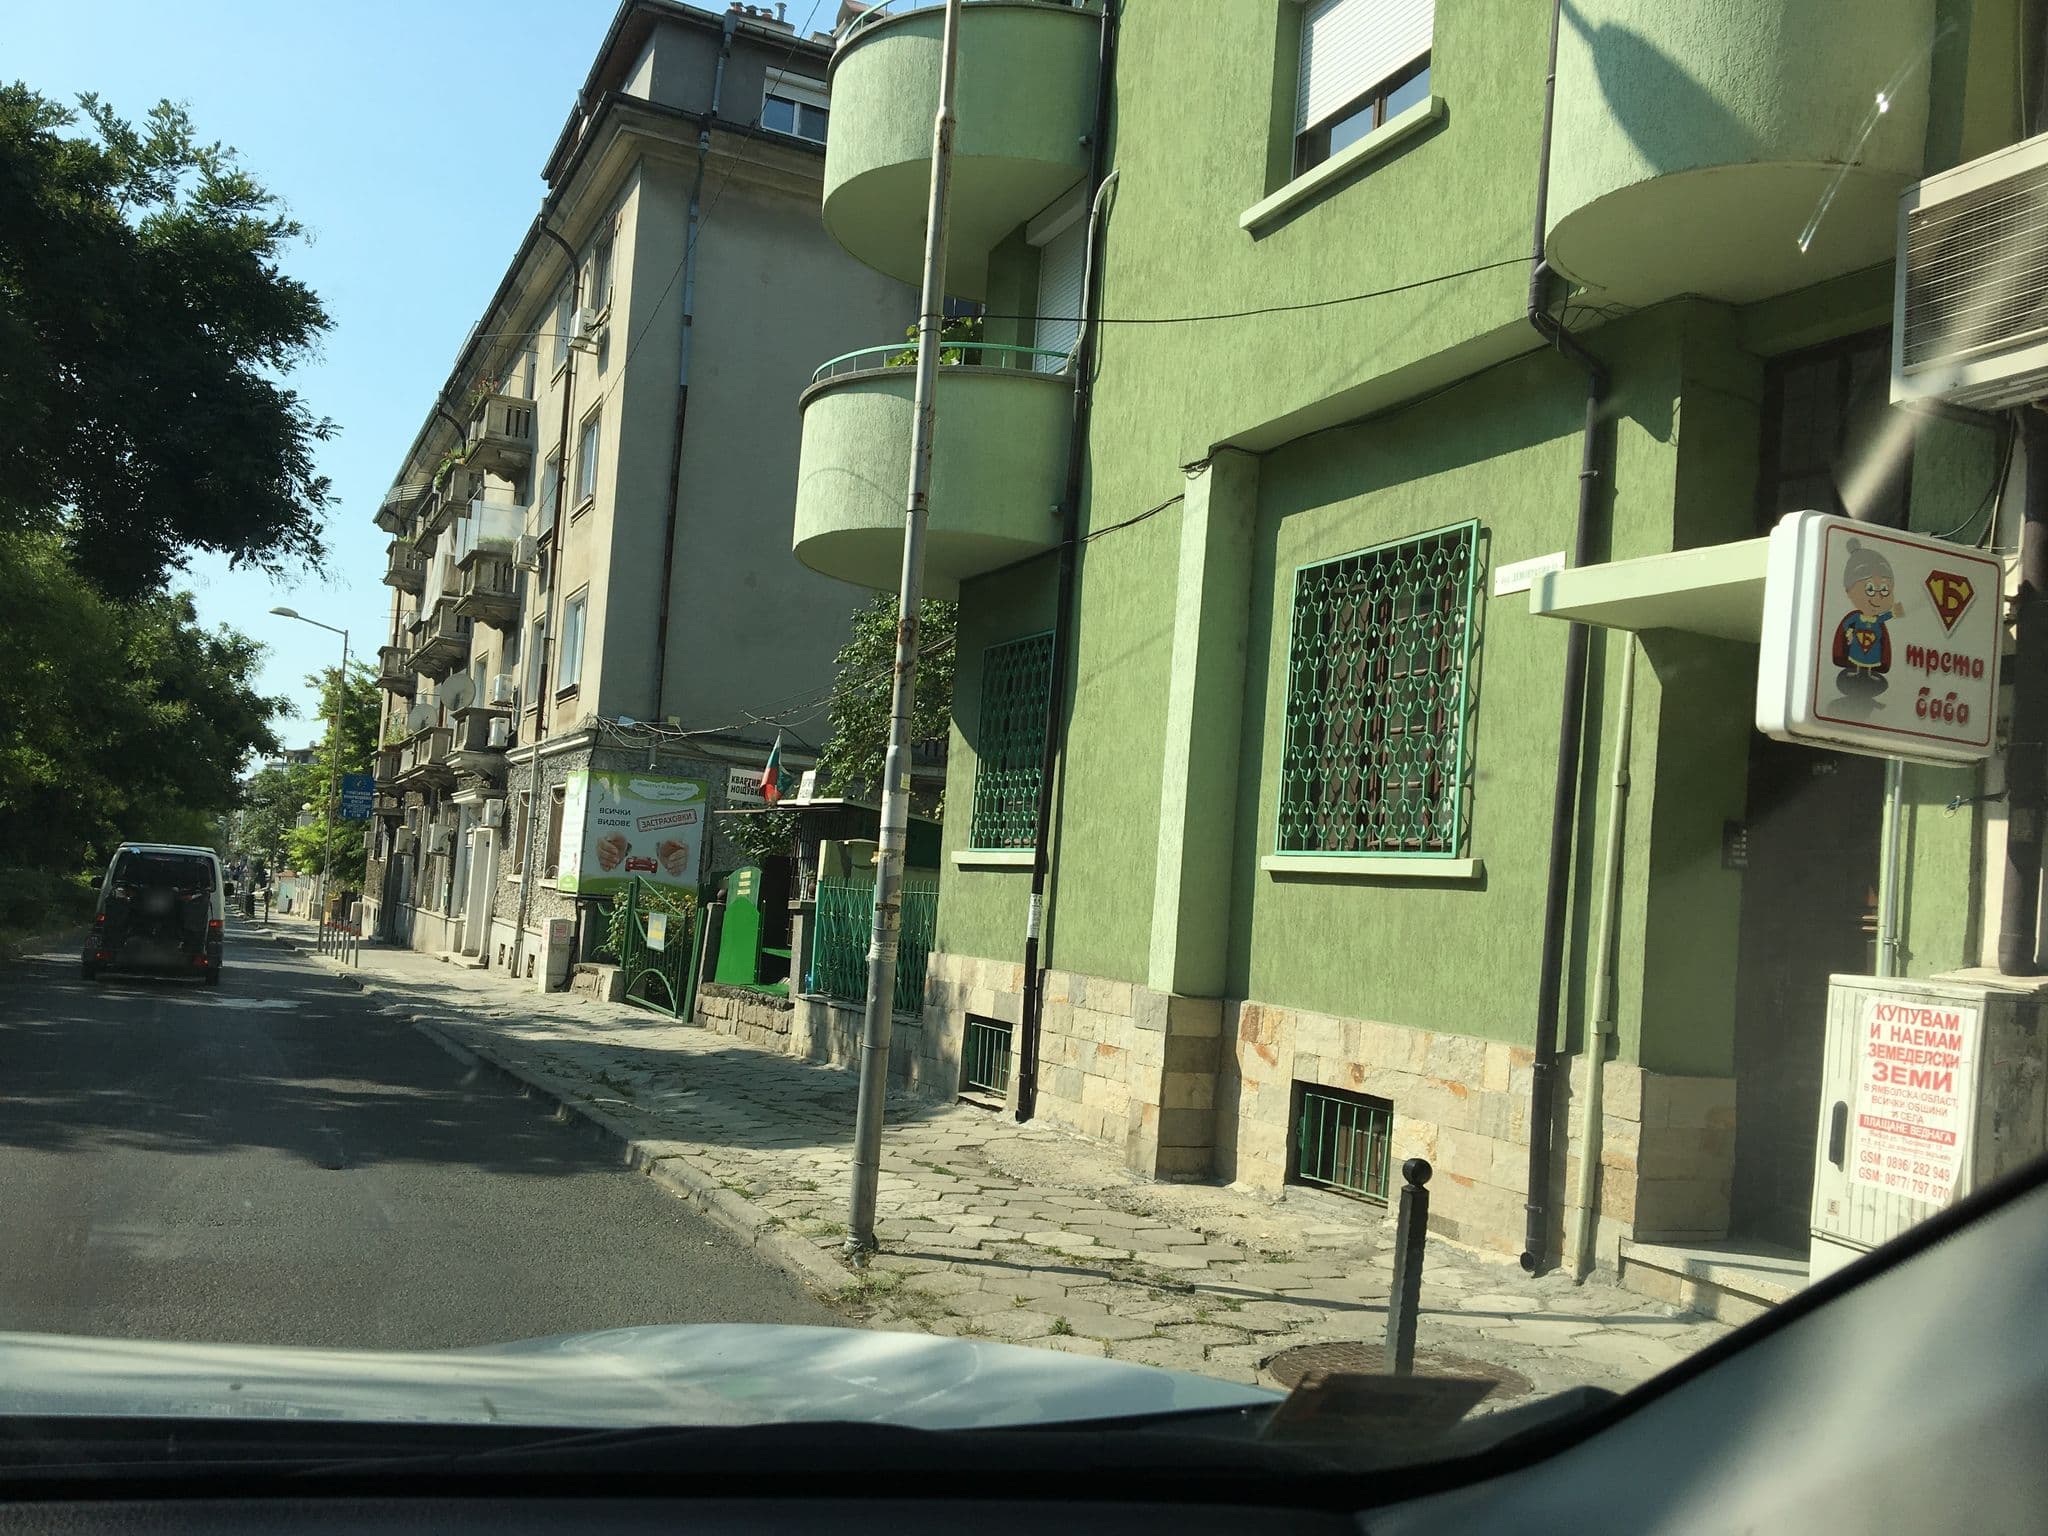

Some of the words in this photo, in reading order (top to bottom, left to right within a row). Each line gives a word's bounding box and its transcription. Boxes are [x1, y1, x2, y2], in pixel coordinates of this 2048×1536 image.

[1915, 686, 1970, 725] баба
[599, 807, 632, 816] ВСИЧКИ
[597, 818, 632, 828] ВИДОВЕ
[641, 812, 693, 829] ЗАСТРАХОВКИ
[1876, 1004, 1960, 1031] КУПУВАМ
[1870, 1023, 1881, 1039] И
[1890, 1025, 1962, 1051] НАЕМАМ
[1868, 1042, 1960, 1069] ЗЕМЕДЕЛСКИ
[1872, 1061, 1953, 1093] ЗЕМИ
[1871, 1084, 1919, 1100] ЯМБОЛСКА
[1871, 1095, 1905, 1108] ВСИЧКИ
[1863, 1115, 1910, 1135] ПЛАЩАНЕ
[1910, 1124, 1953, 1144] ВЕДНАГА
[1913, 1161, 1931, 1177] 282
[1912, 1179, 1930, 1195] 797
